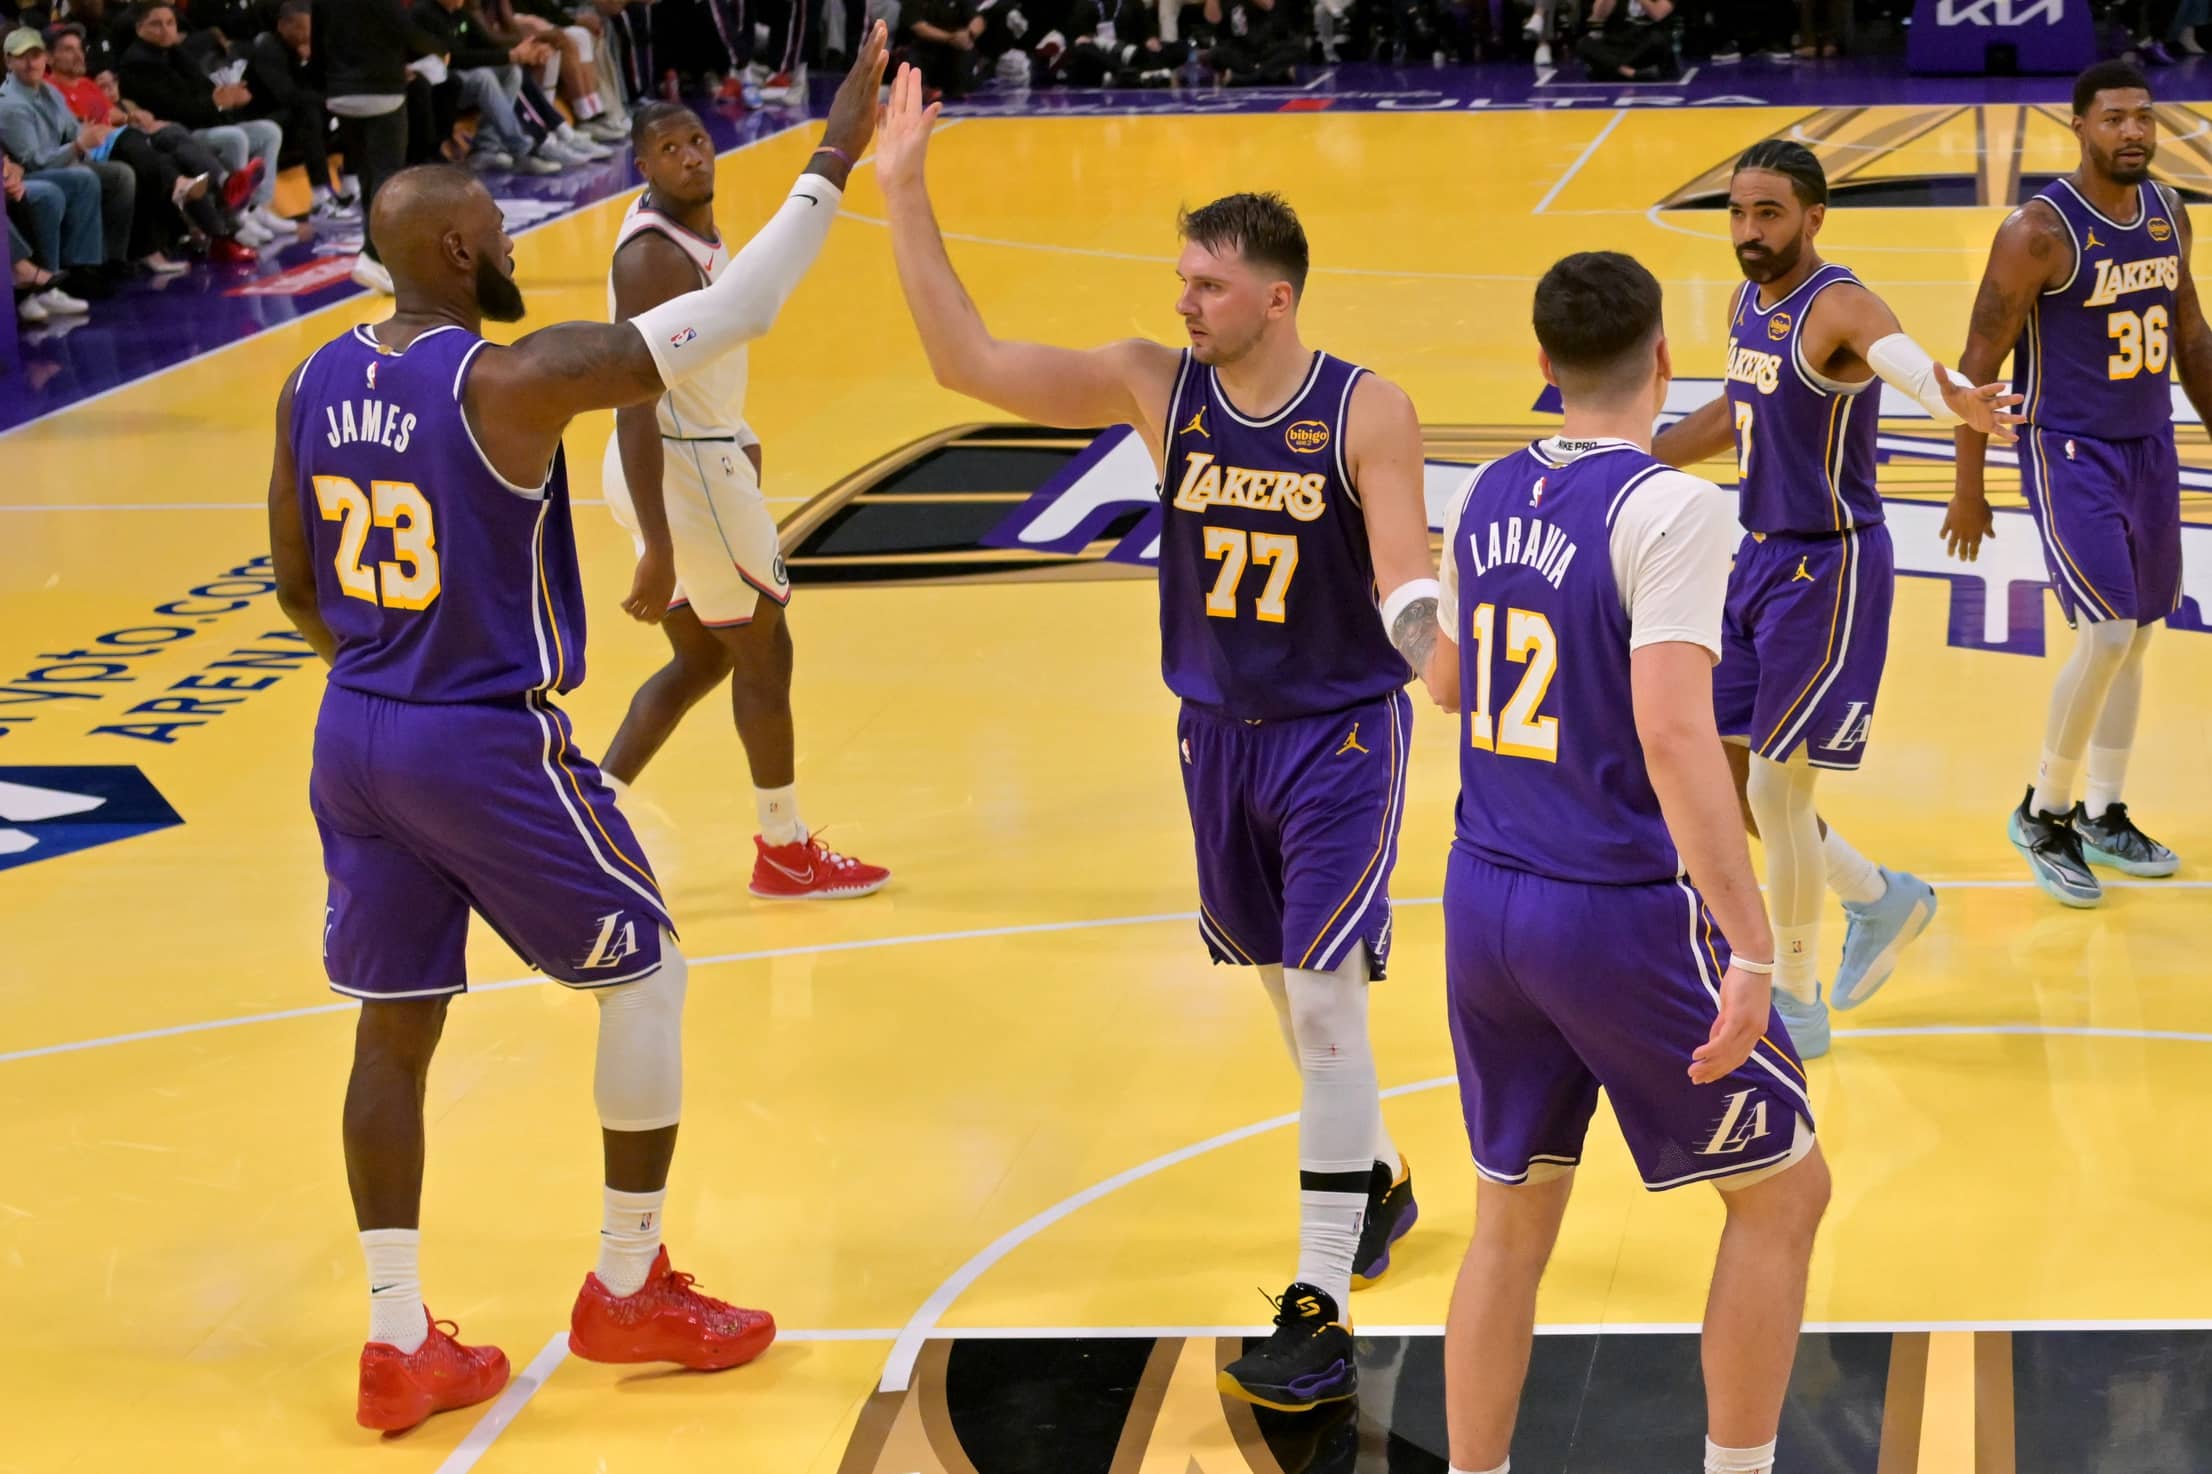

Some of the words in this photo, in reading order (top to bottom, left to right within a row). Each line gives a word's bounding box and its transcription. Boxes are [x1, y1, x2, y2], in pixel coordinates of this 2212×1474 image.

[1937, 0, 2064, 26] KIA
[1376, 94, 1769, 110] ULTRA
[2083, 255, 2179, 307] LAKERS
[2107, 304, 2169, 381] 36
[326, 399, 416, 453] JAMES
[1290, 429, 1327, 444] bibigo
[1575, 441, 1598, 451] PRO
[1173, 451, 1327, 522] LAKERS
[312, 475, 441, 611] 23
[1470, 517, 1577, 590] LARAVIA
[1202, 526, 1299, 624] 77
[1470, 602, 1559, 764] 12
[1818, 701, 1873, 752] LA
[573, 909, 641, 970] LA
[1692, 1087, 1772, 1155] LA
